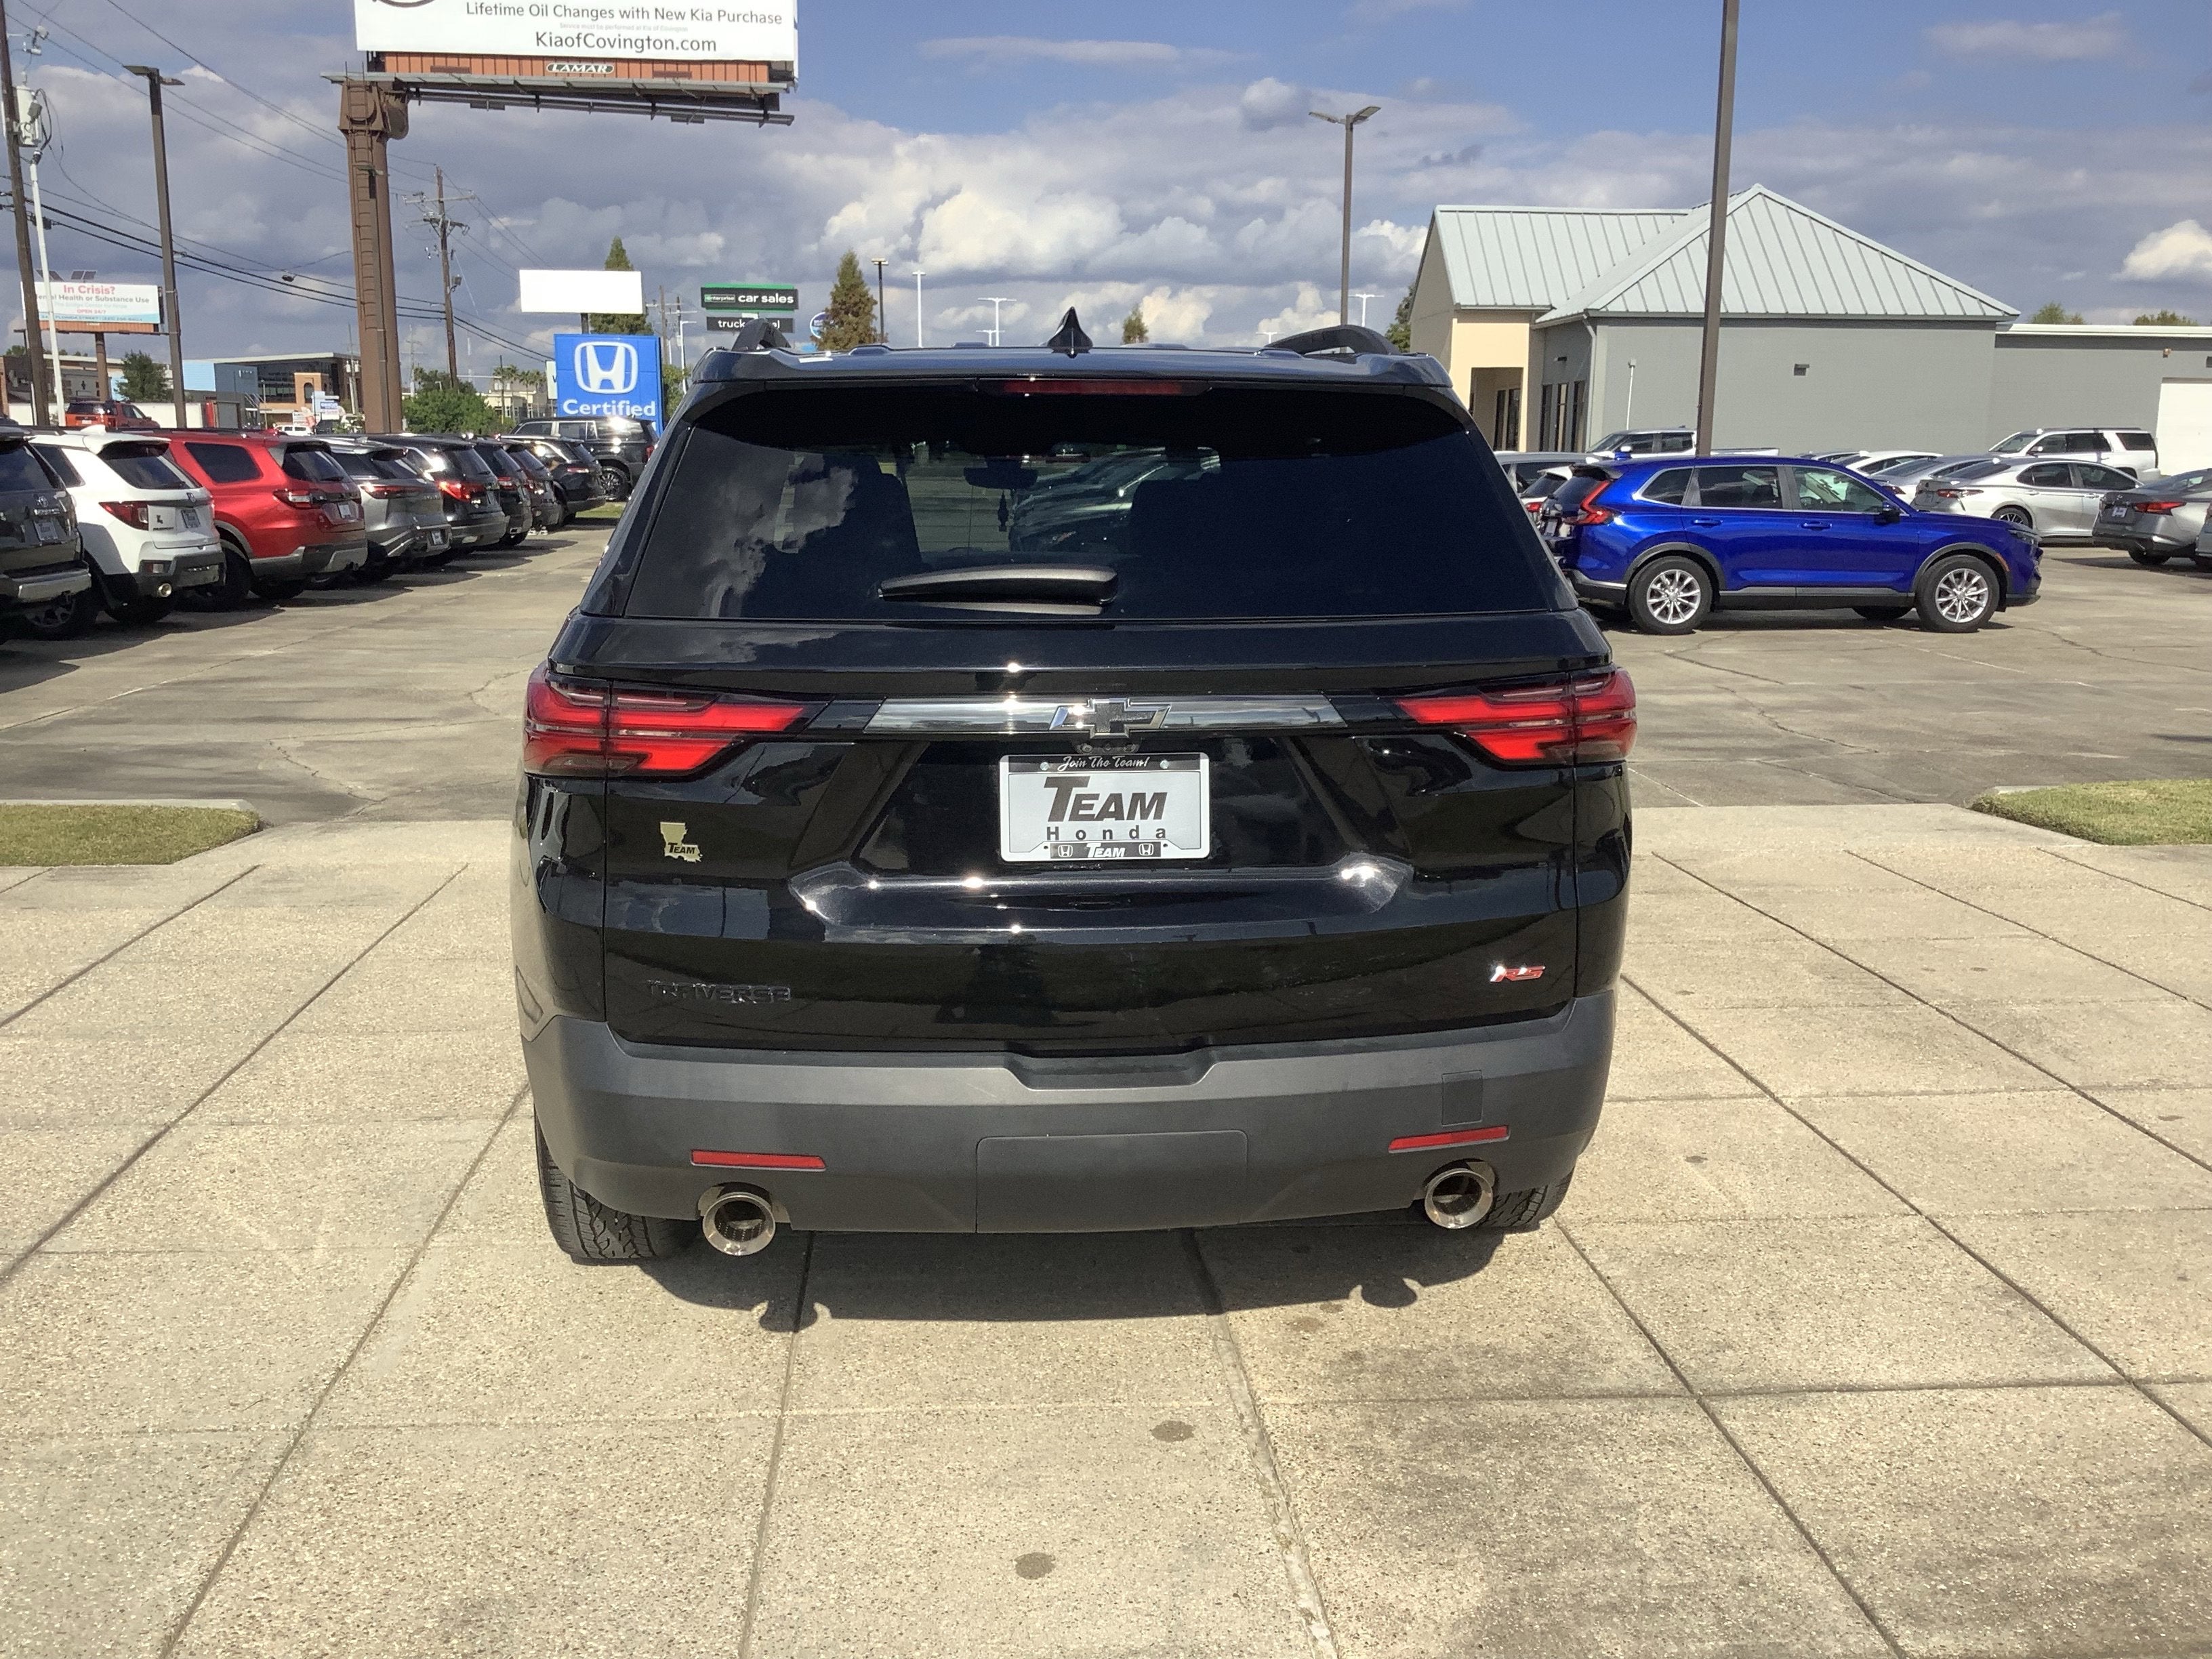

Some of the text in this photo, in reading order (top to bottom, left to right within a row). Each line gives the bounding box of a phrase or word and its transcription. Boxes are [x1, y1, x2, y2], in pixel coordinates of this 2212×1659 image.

[466, 2, 783, 24] Lifetime Oil Changes with New Kia Purchase
[535, 32, 716, 53] KiaofCovington.com
[552, 64, 608, 73] LAMAR
[64, 285, 115, 295] In Crisis?
[738, 293, 794, 304] car sales
[718, 319, 745, 328] truck
[562, 398, 656, 417] Certified
[1057, 755, 1151, 772] Join The Team!
[1044, 775, 1168, 822] TEAM
[1046, 825, 1167, 840] Honda
[668, 842, 696, 855] TEAM
[1086, 842, 1126, 859] TEAM
